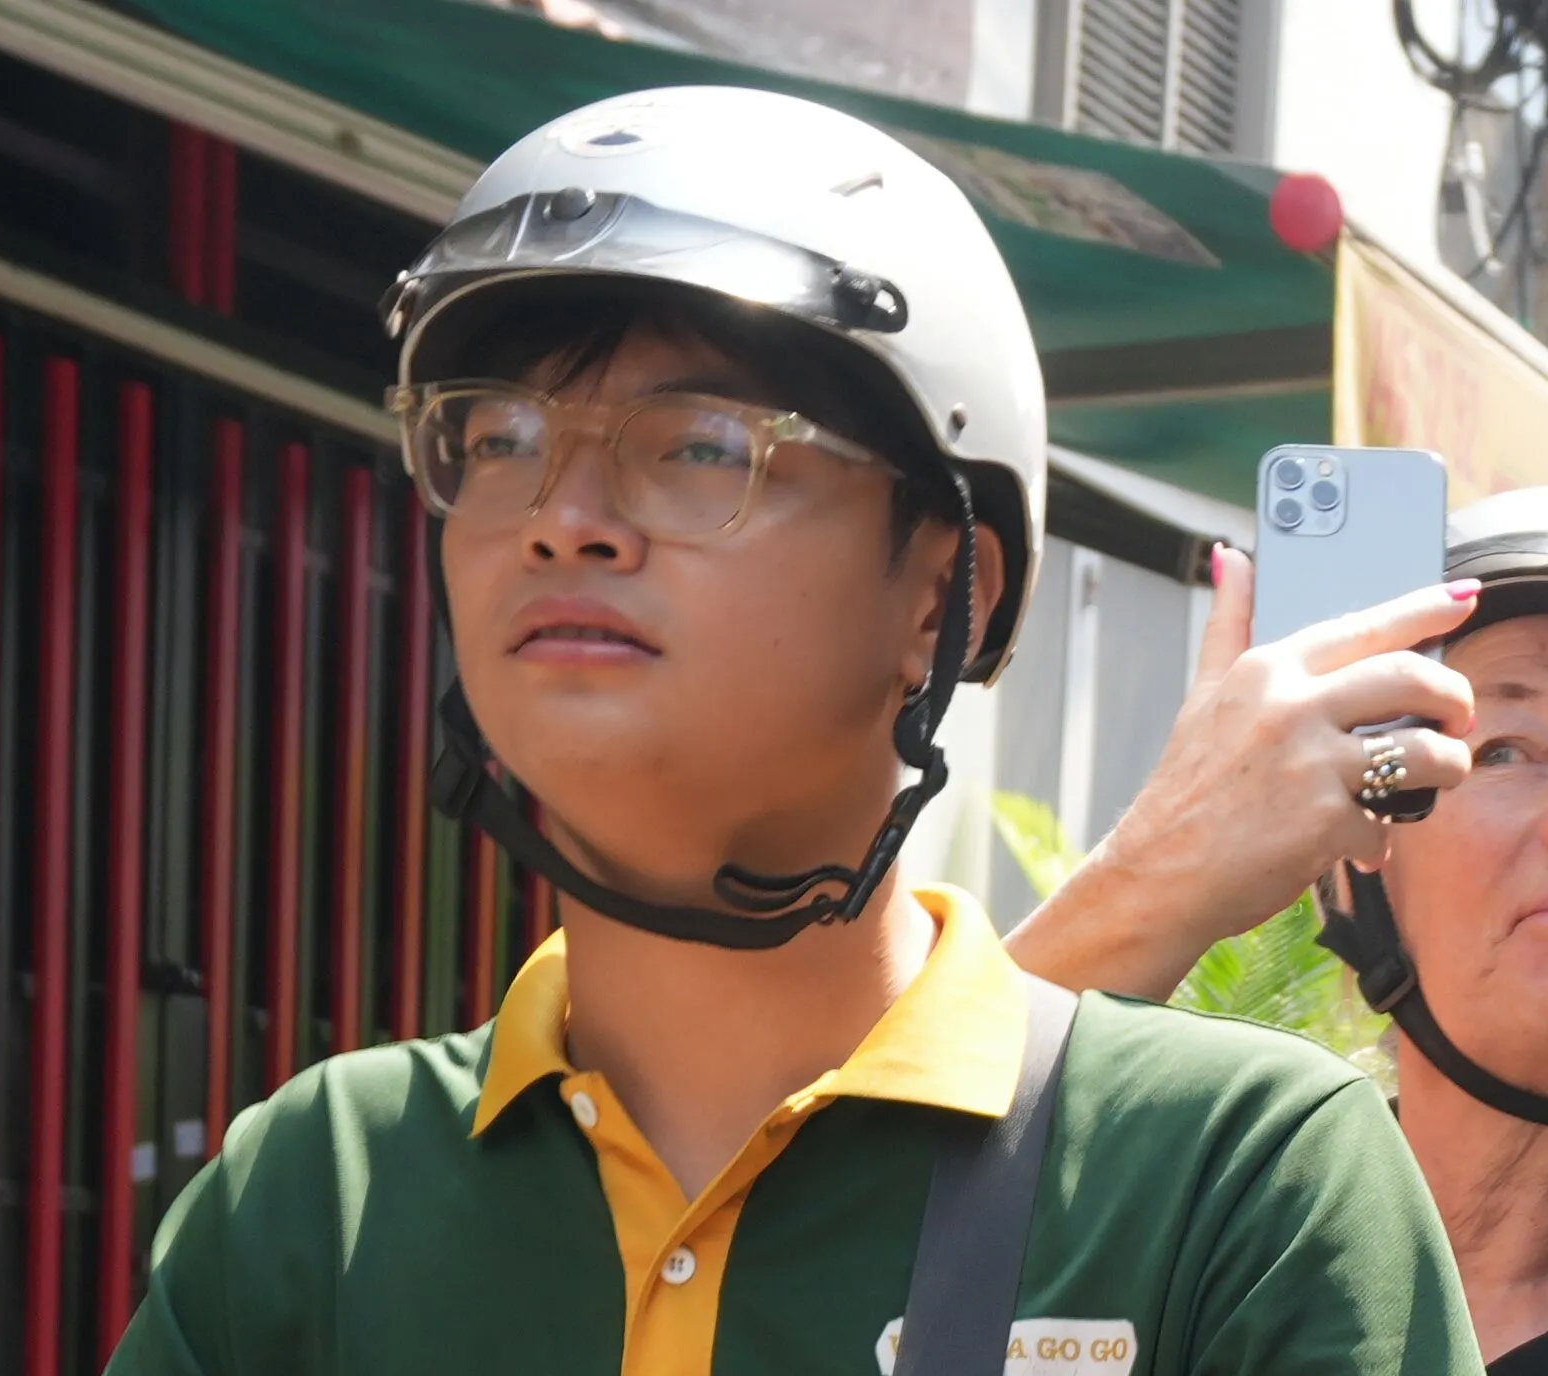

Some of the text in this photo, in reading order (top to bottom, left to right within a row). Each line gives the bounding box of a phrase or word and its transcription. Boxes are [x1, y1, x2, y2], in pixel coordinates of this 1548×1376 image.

[1007, 1337, 1127, 1361] A GO GO
